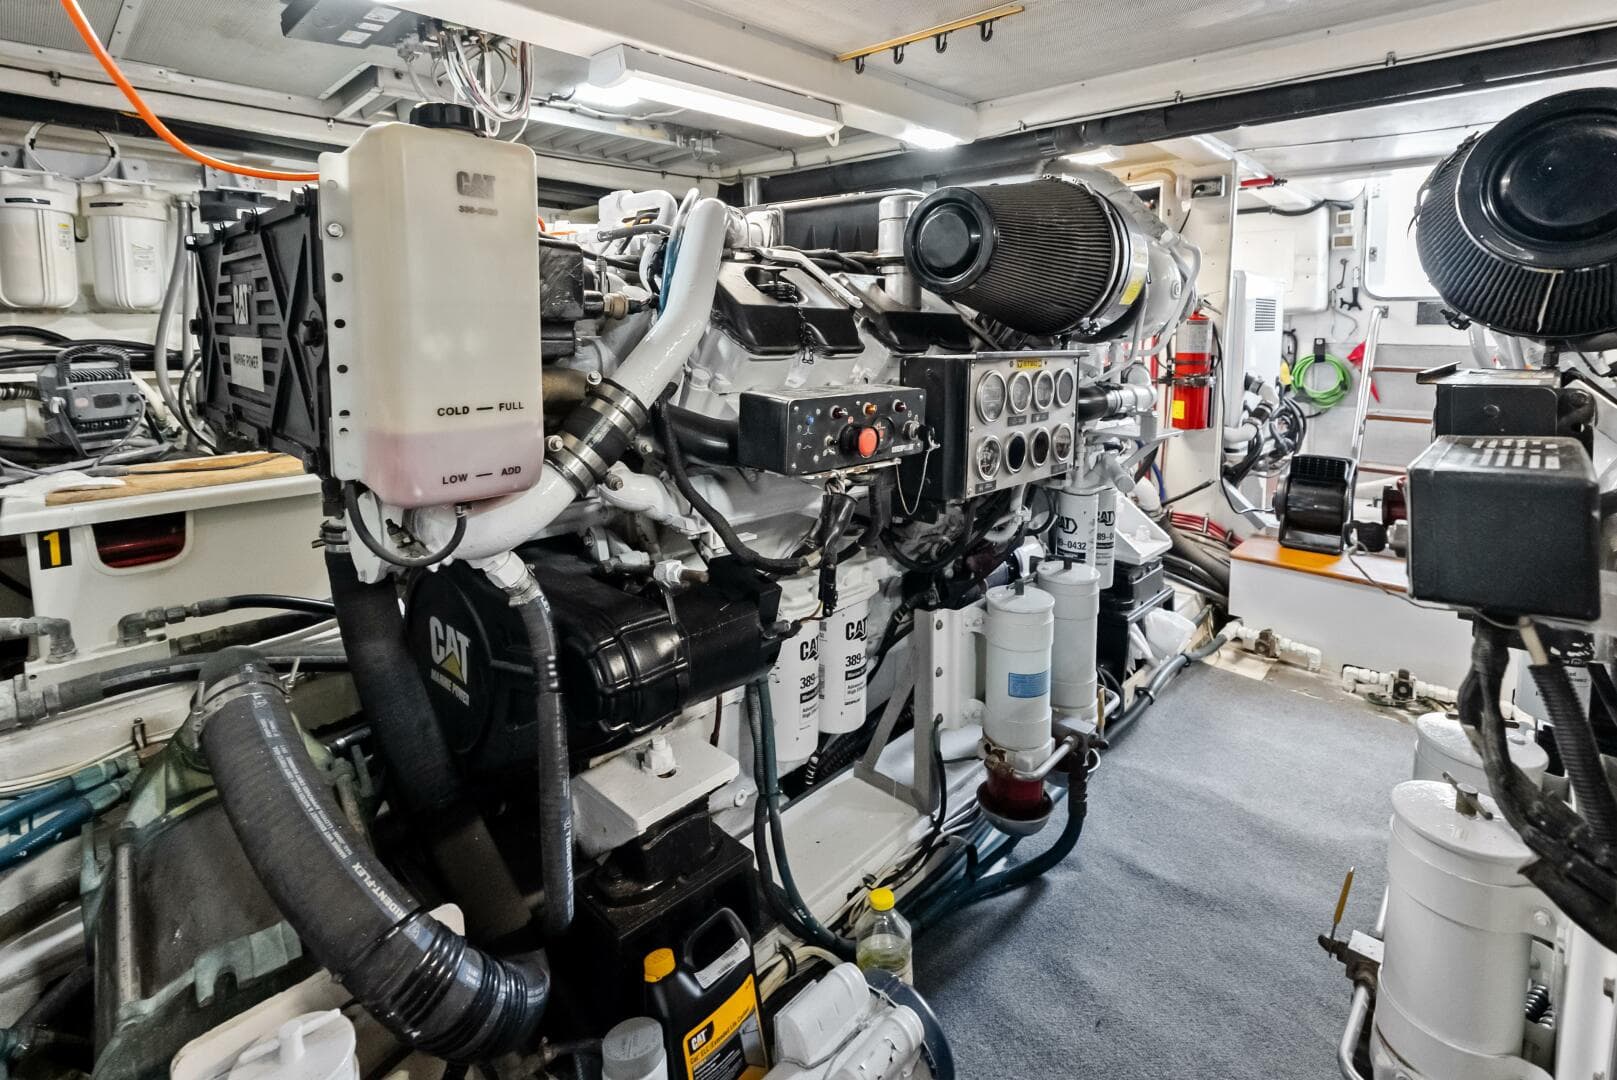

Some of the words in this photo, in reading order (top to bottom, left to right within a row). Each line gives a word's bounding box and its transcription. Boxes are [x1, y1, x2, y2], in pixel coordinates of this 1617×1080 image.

[456, 171, 495, 198] CAT
[233, 284, 248, 325] CAT
[437, 406, 470, 416] COLD
[499, 402, 524, 411] FULL
[442, 473, 468, 485] LOW
[501, 466, 521, 476] ADD
[43, 531, 62, 566] 1
[430, 616, 470, 685] CAT
[352, 862, 407, 918] RIDENT-FLEX
[690, 1029, 708, 1051] CAT
